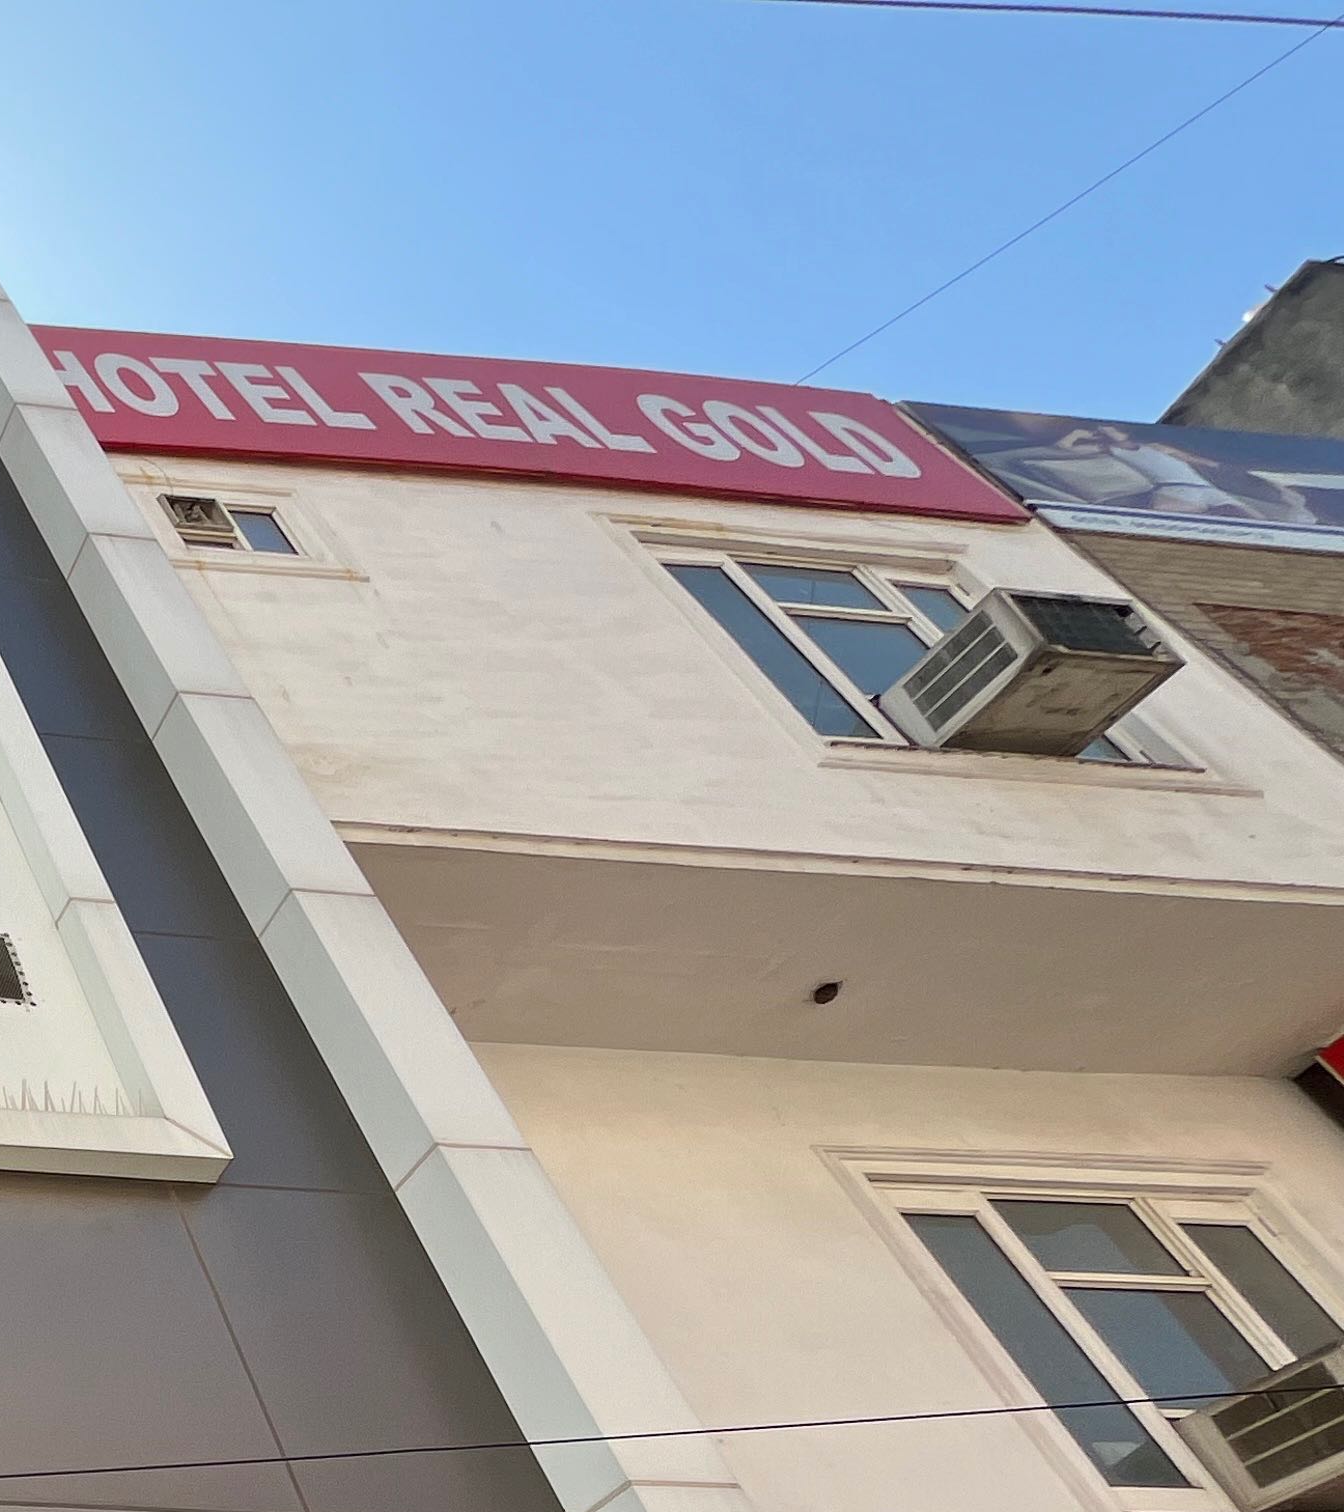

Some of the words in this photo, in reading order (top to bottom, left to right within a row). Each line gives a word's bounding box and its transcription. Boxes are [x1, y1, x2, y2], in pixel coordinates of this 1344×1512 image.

[53, 350, 377, 430] HOTEL
[358, 372, 657, 454] REAL
[636, 393, 922, 478] GOLD
